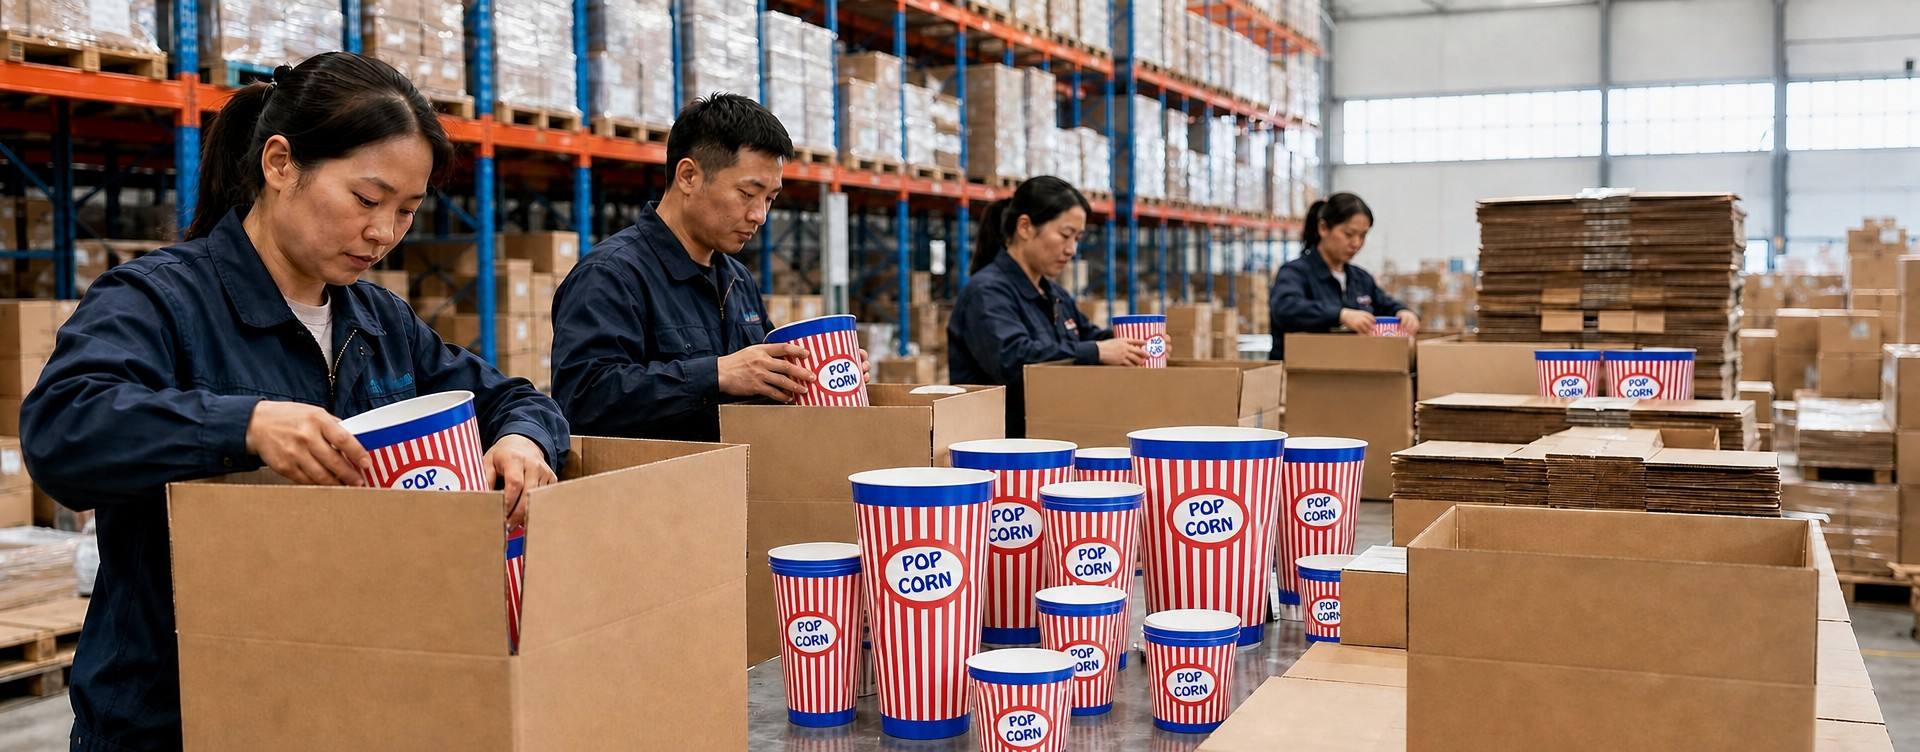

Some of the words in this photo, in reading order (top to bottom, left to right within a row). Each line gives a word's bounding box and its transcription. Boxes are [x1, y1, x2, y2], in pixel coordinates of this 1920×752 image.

[829, 361, 851, 375] POP
[829, 374, 857, 389] CORN
[1561, 378, 1579, 387] POP
[1629, 378, 1648, 387] POP
[1559, 389, 1583, 397] CORN
[1627, 387, 1653, 398] CORN
[1189, 500, 1224, 516] POP
[1307, 497, 1330, 508] POP
[992, 507, 1025, 523] POP
[1304, 509, 1335, 521] CORN
[1185, 517, 1233, 535] CORN
[989, 524, 1033, 542] CORN
[1079, 547, 1106, 560] POP
[902, 551, 941, 571] POP
[1075, 561, 1112, 576] CORN
[898, 572, 952, 594] CORN
[1320, 602, 1338, 610] POP
[798, 620, 822, 632] POP
[796, 633, 829, 646] CORN
[1071, 647, 1094, 658] POP
[1076, 660, 1099, 671] ORN
[1177, 672, 1202, 682] POP
[1174, 685, 1208, 696] CORN
[1009, 715, 1035, 726] POP
[1007, 727, 1041, 740] CORN
